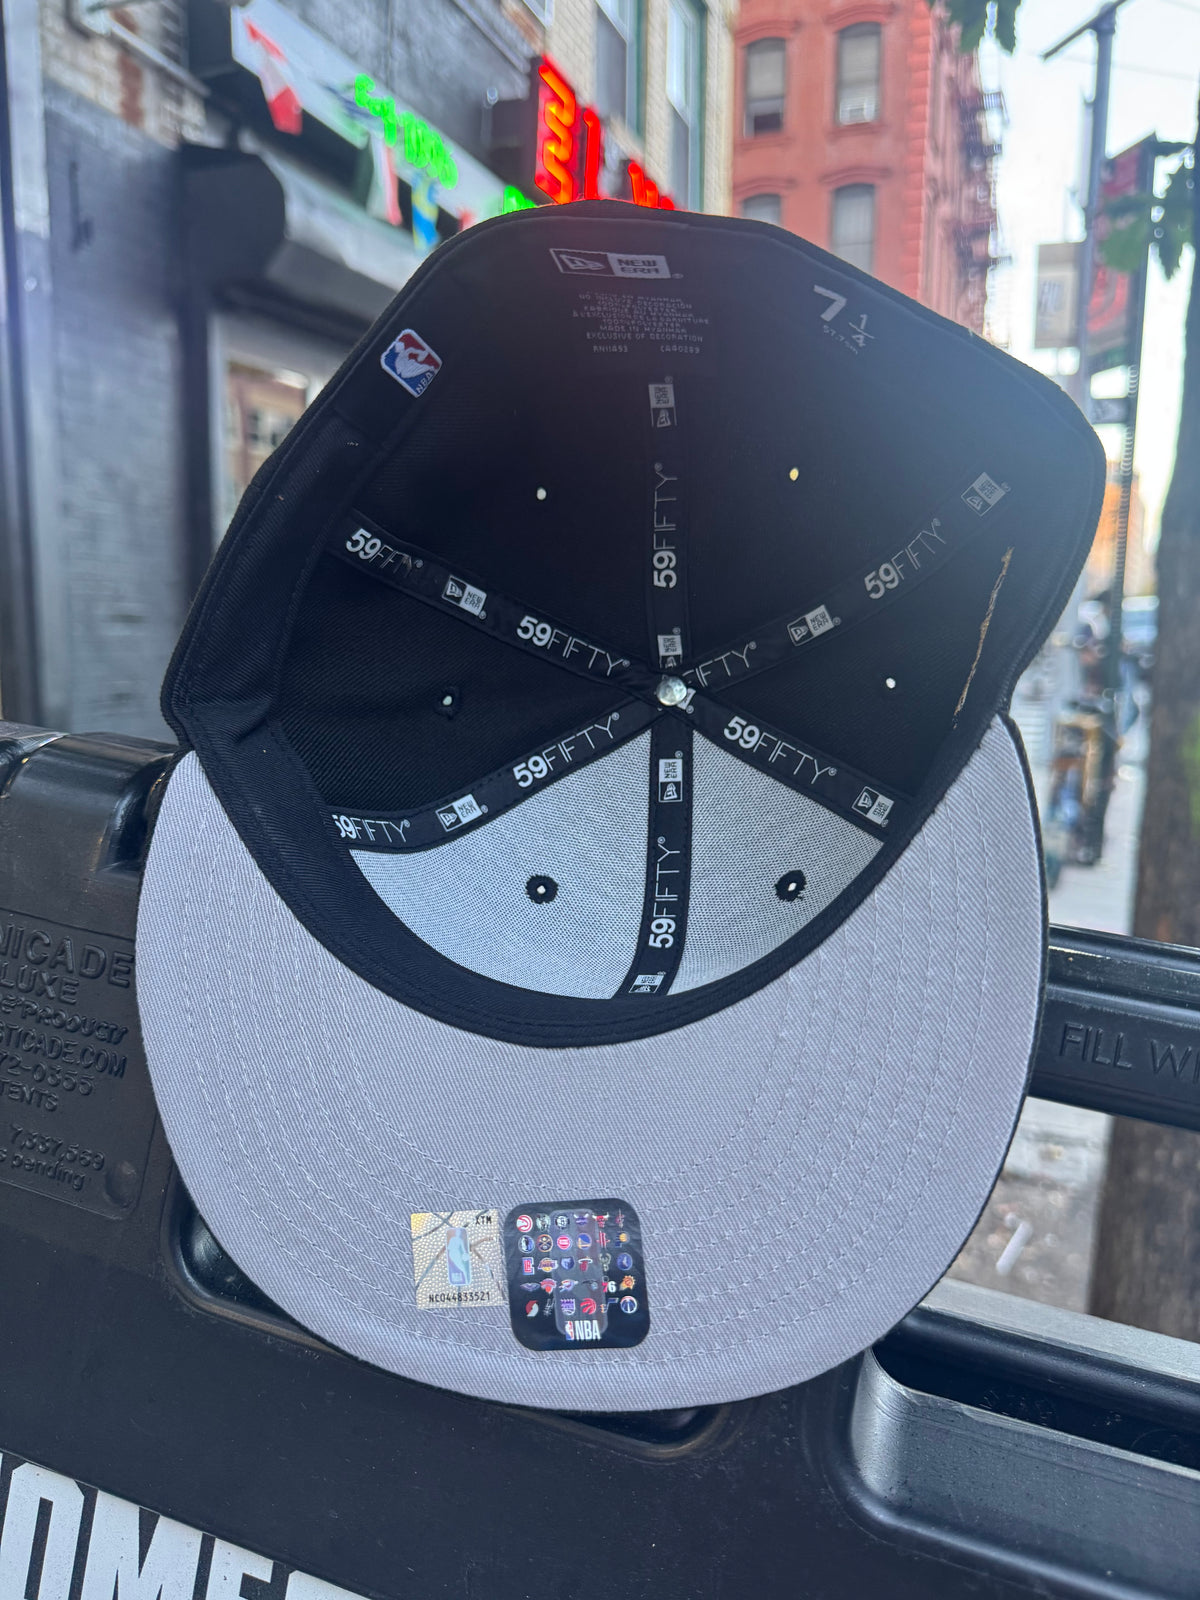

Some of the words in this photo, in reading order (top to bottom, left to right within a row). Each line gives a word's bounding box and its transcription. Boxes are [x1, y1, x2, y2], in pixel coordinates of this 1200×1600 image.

[617, 258, 657, 267] NEW
[620, 266, 661, 275] ERA
[813, 284, 848, 322] 7
[586, 329, 631, 342] EXCLUSIVE
[650, 333, 703, 342] DECORATION
[516, 615, 625, 676] 59FIFTY
[513, 715, 614, 788] 59FIFTY
[723, 716, 832, 784] 59FIFTY
[648, 843, 681, 949] 59FIFTY
[1059, 1021, 1133, 1070] FILL
[574, 1320, 601, 1341] NBA
